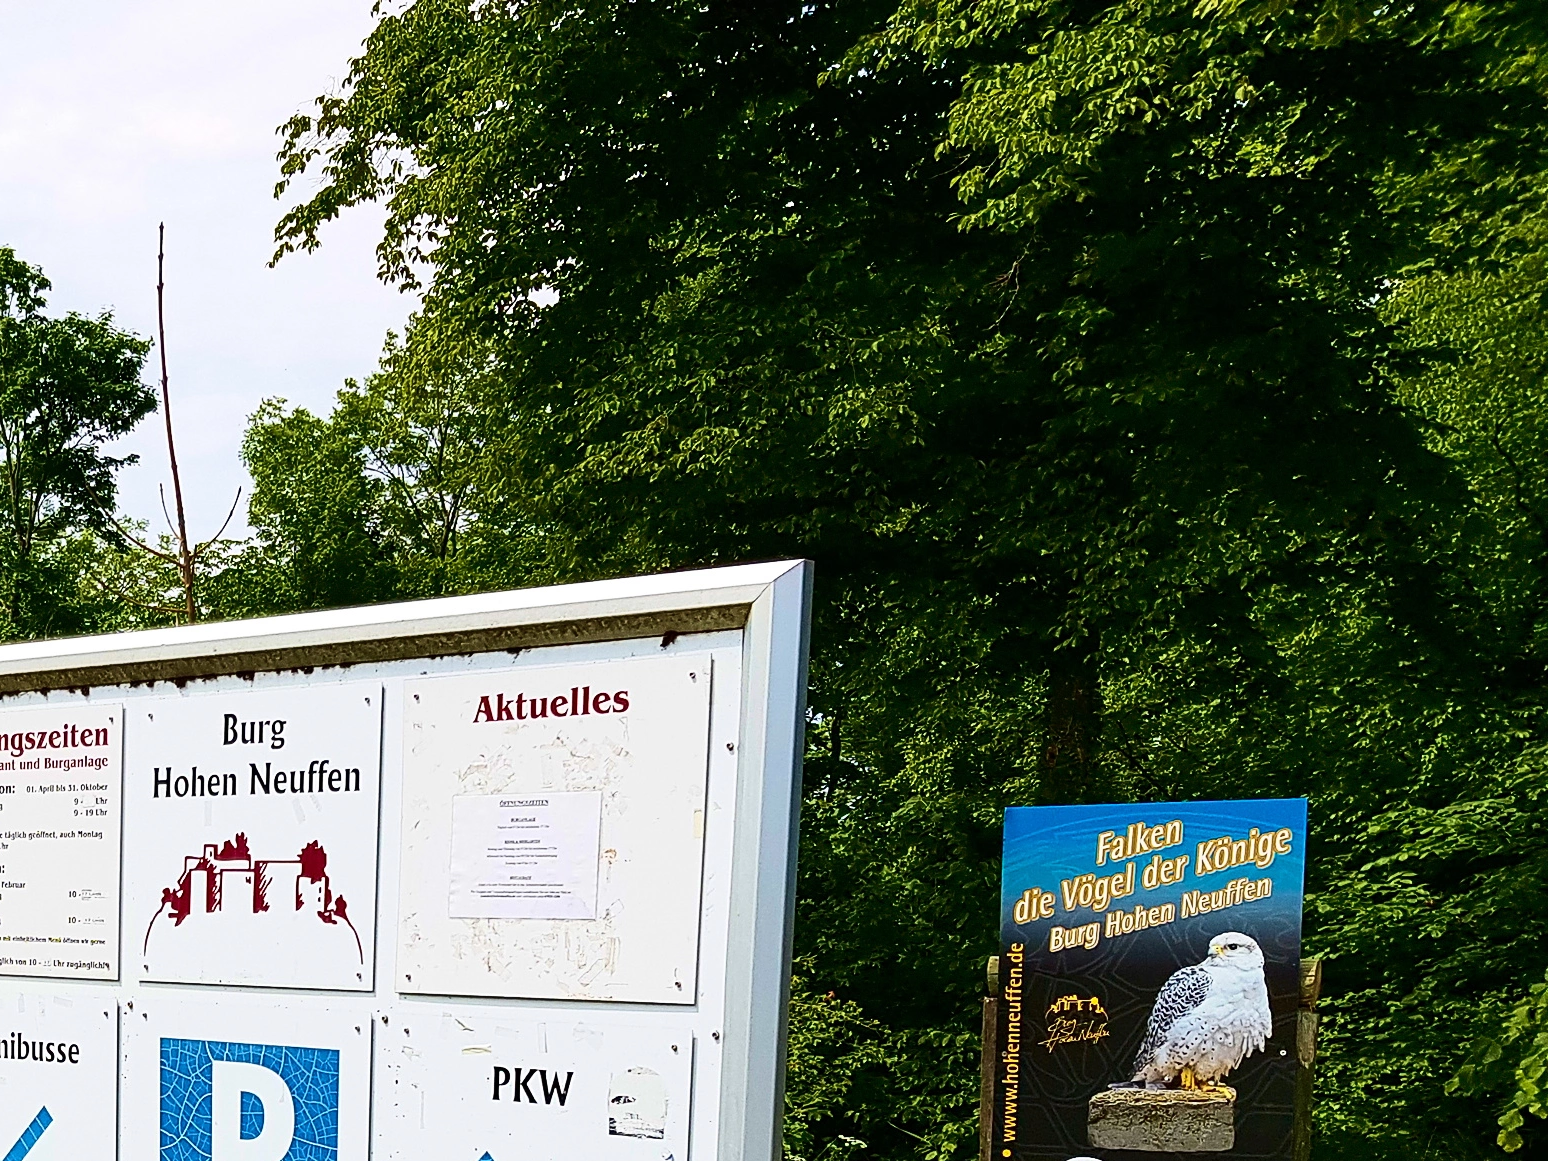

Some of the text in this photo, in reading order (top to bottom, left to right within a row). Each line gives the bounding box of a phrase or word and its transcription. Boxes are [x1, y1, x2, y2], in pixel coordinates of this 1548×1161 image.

[472, 685, 630, 724] Aktuelles
[222, 714, 286, 750] Burg
[19, 758, 40, 770] und
[44, 756, 109, 772] Burganlage
[152, 760, 361, 798] Hohen Neuffen
[38, 784, 54, 794] April
[56, 784, 66, 792] bis
[80, 782, 108, 792] Oktober
[78, 830, 103, 840] Montag
[1096, 819, 1184, 866] Falken
[68, 890, 77, 898] 10
[1014, 827, 1292, 924] die Vögel der Könige
[68, 916, 77, 924] 10
[1050, 877, 1272, 952] Burg Hohen Neuffen
[1002, 942, 1024, 1142] wwww.hohenneuffen.de
[492, 1066, 574, 1107] PKW
